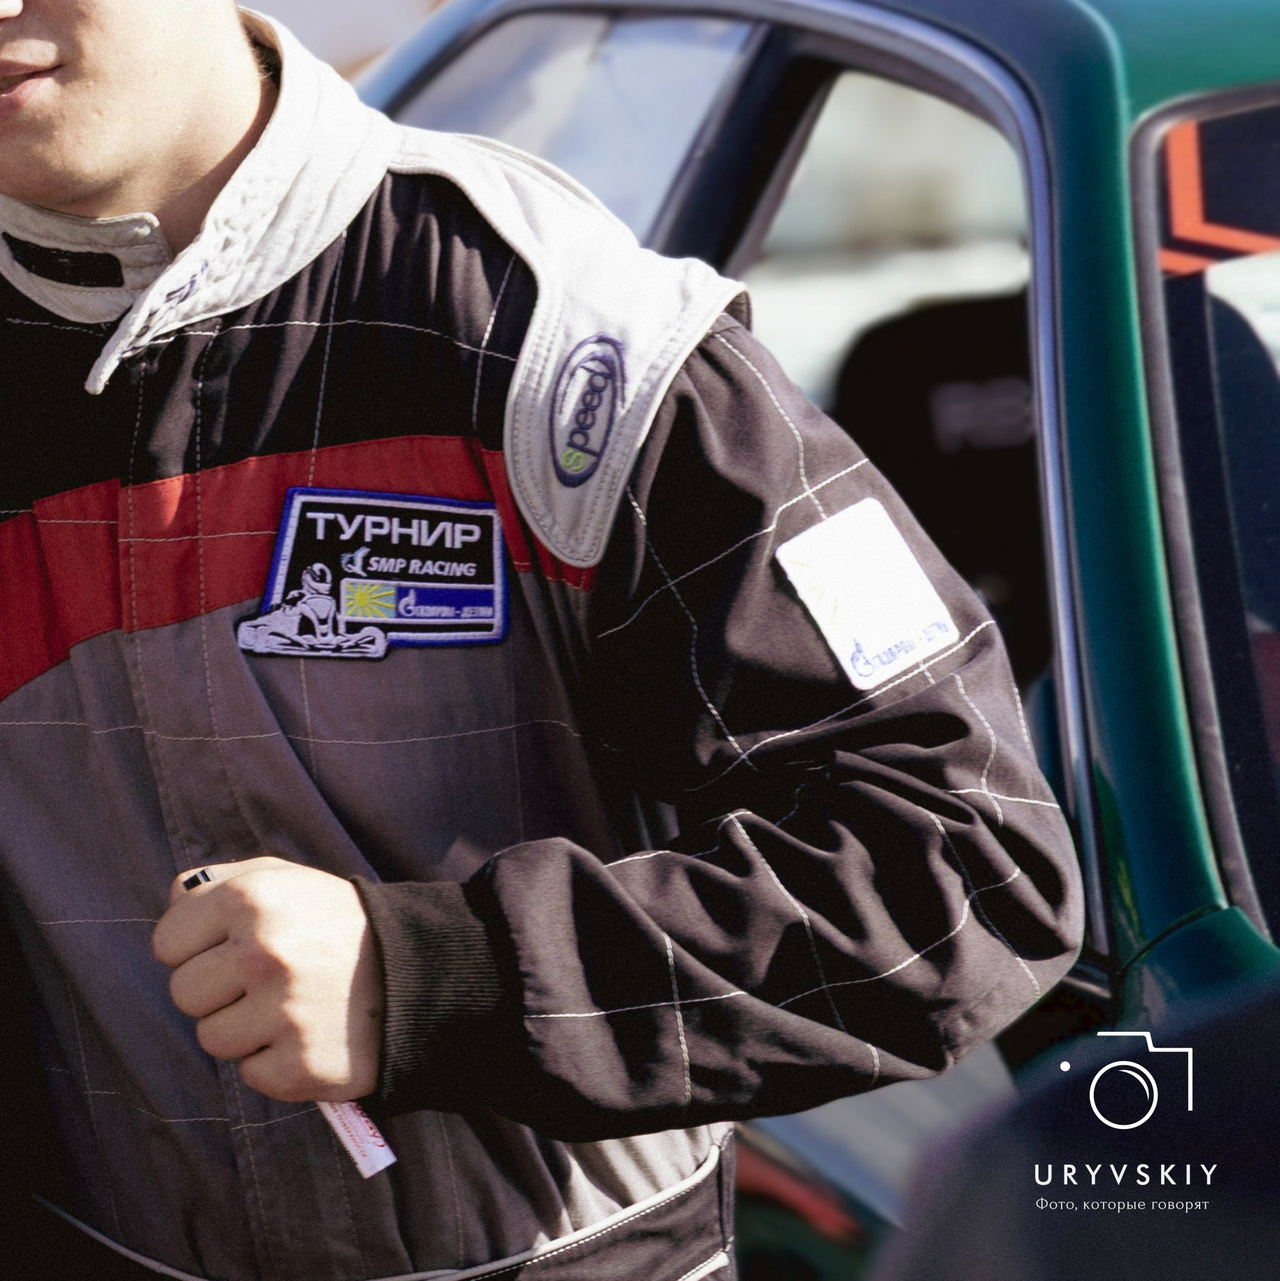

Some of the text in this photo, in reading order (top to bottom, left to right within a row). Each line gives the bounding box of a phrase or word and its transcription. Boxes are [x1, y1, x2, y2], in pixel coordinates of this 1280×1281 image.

[561, 365, 615, 471] speed
[305, 512, 482, 549] ТУРНИР
[367, 557, 478, 577] SMP RACING
